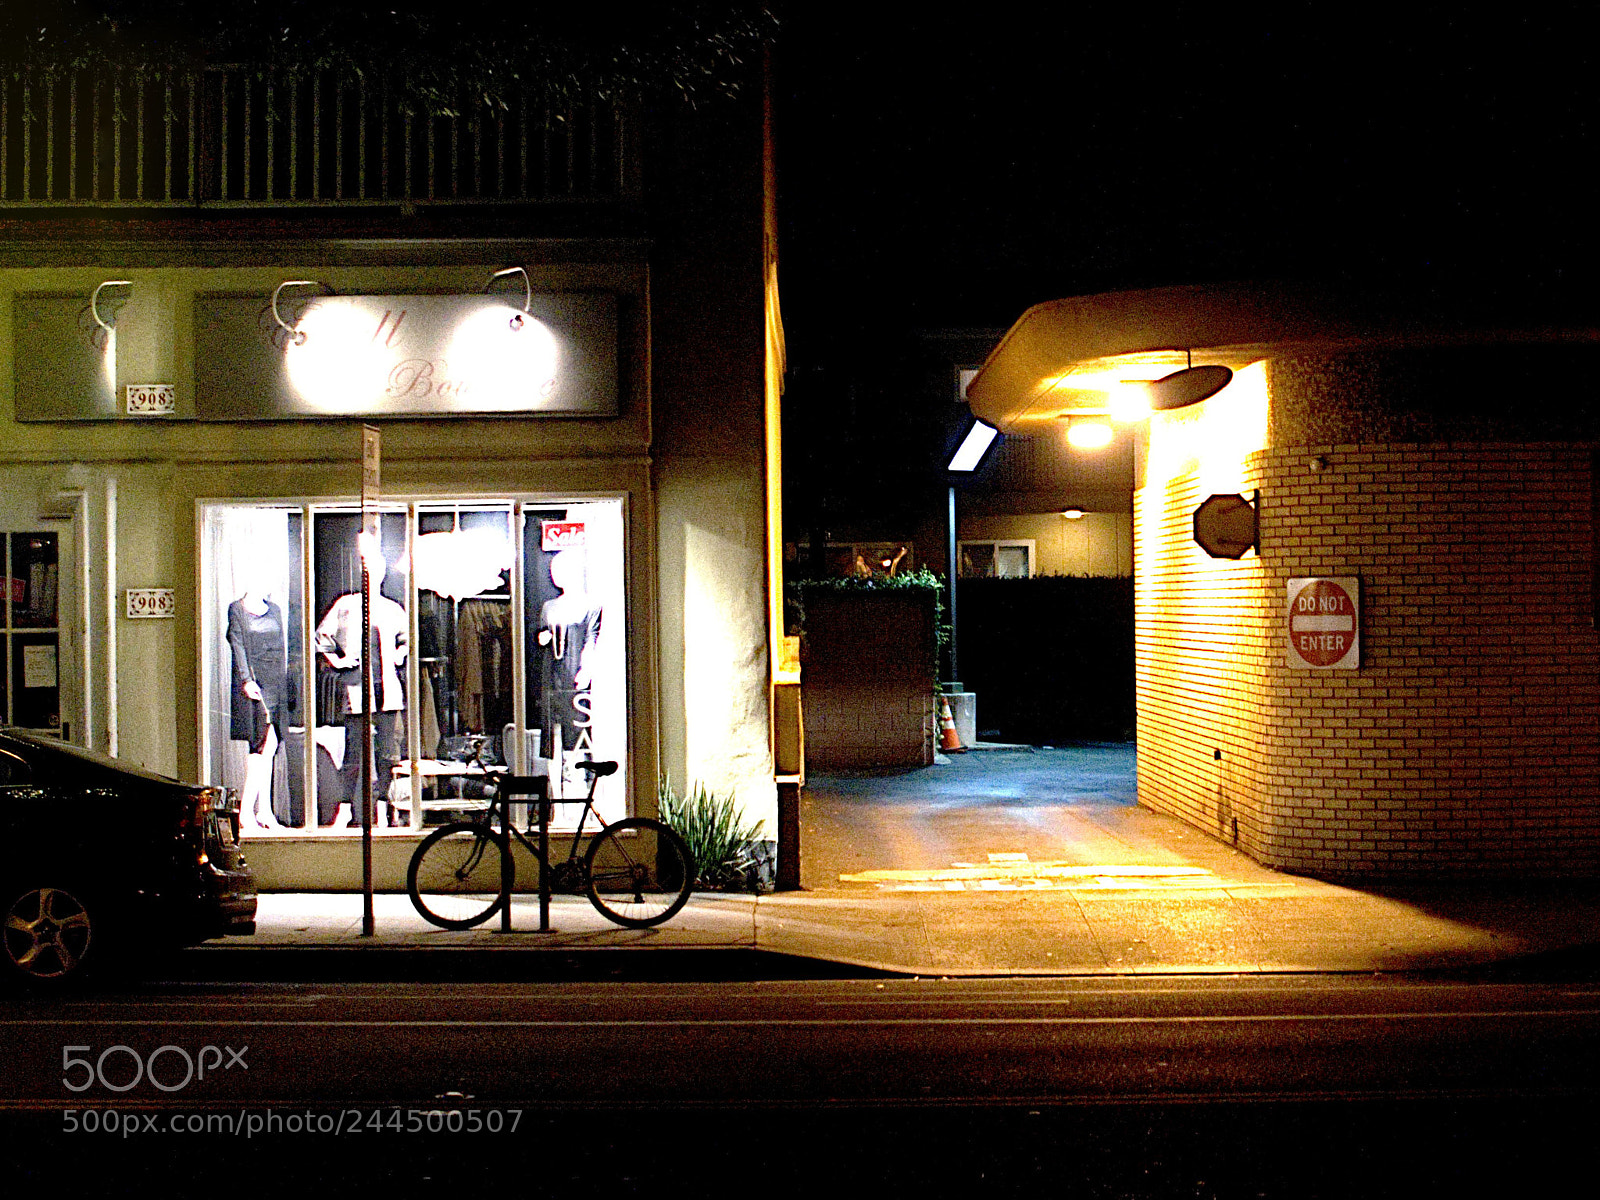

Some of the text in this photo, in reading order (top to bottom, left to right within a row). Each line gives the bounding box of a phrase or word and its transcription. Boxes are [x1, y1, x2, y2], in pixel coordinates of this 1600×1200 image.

[138, 392, 166, 406] 908
[138, 596, 166, 610] 908
[1299, 596, 1345, 612] DO NOT
[1300, 635, 1344, 651] ENTER
